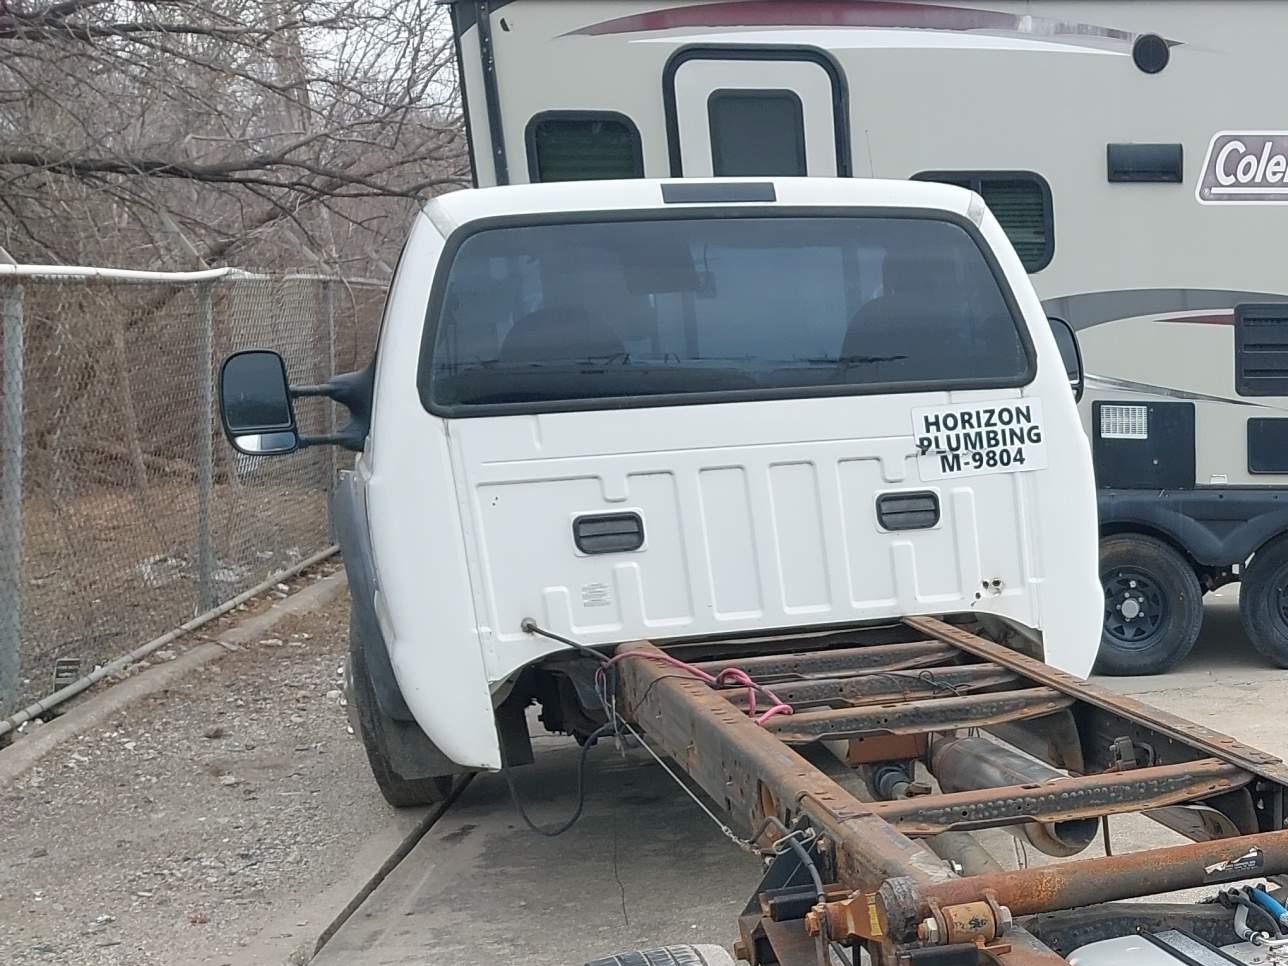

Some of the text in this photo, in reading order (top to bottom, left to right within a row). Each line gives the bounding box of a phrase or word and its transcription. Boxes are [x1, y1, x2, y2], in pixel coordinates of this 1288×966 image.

[923, 405, 1032, 433] HORIZON
[918, 425, 1042, 456] PLUMBING
[940, 447, 1026, 473] M-9804
